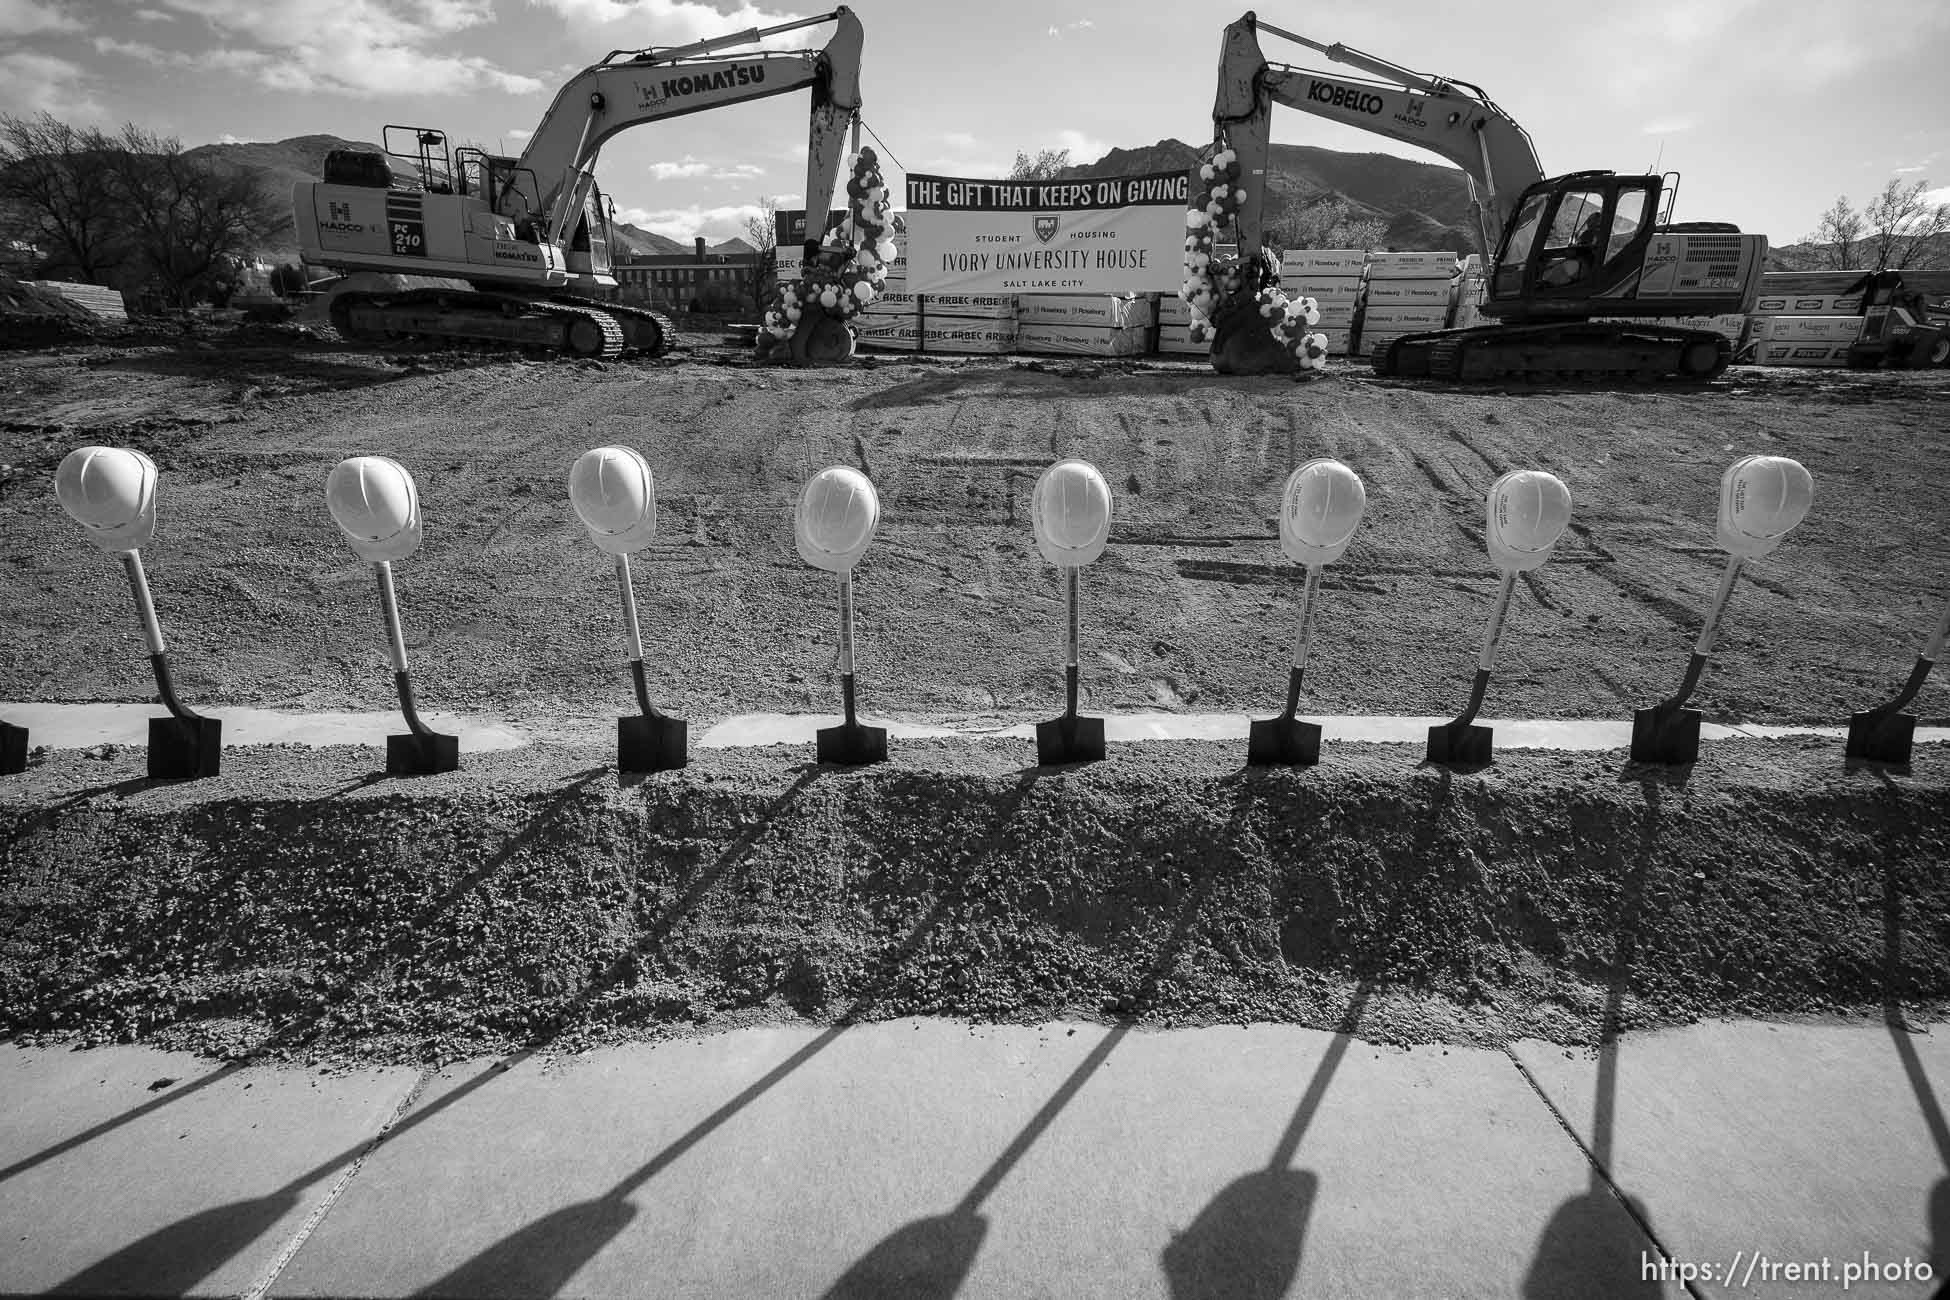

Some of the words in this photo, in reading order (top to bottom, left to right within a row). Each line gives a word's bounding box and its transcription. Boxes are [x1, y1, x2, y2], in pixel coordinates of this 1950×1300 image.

[661, 63, 765, 98] KOMATSU
[1307, 80, 1383, 115] KOBELCO
[908, 181, 941, 205] THE
[947, 183, 984, 206] GIFT
[989, 185, 1033, 206] THAT
[1039, 184, 1092, 206] KEEPS
[1097, 182, 1121, 204] ON
[1127, 176, 1188, 203] GIVING
[320, 223, 362, 232] HADCO
[394, 224, 408, 233] PC
[395, 234, 420, 246] 210
[1070, 231, 1116, 239] HOUSING
[496, 251, 538, 262] KOMATSU
[943, 253, 990, 272] IVORY
[996, 250, 1090, 270] UNIVERSITY
[1096, 249, 1149, 269] HOUSE
[1003, 280, 1027, 288] SALT
[1031, 280, 1057, 288] LAKE
[1061, 279, 1084, 287] CITY
[882, 293, 913, 303] ARBEC
[938, 296, 970, 305] ARBEC
[951, 330, 983, 341] ARBEC
